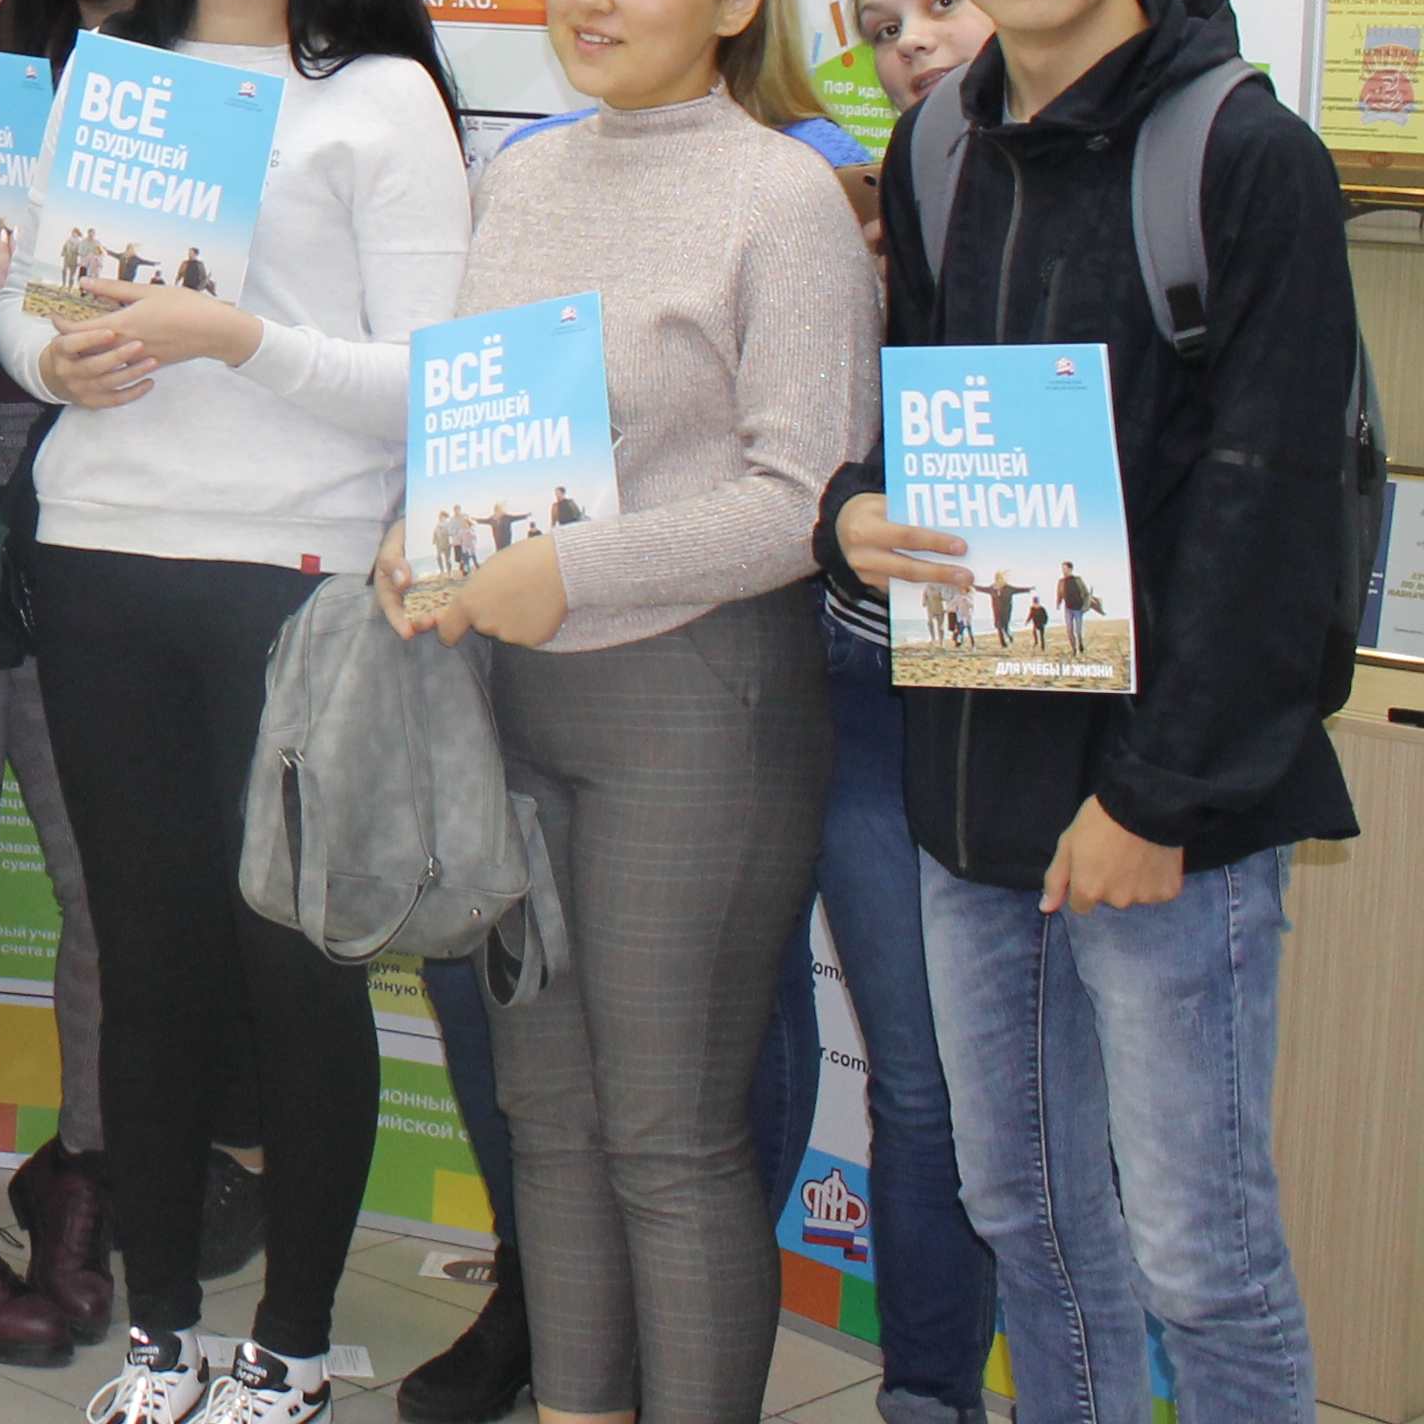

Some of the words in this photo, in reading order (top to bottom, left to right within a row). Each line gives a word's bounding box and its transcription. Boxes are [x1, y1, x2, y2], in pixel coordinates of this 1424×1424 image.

[80, 71, 173, 138] ВСЁ
[823, 80, 854, 94] ПФР
[76, 125, 88, 146] О
[91, 129, 188, 171] БУДУЩЕЙ
[67, 150, 222, 223] ПЕНСИИ
[425, 334, 504, 408] ВСЁ
[425, 412, 437, 434] О
[441, 390, 530, 429] БУДУЩЕЙ
[902, 375, 996, 447] ВСЁ
[426, 416, 572, 478] ПЕНСИИ
[905, 454, 918, 476] О
[922, 447, 1029, 480] БУДУЩЕЙ
[906, 483, 1080, 529] ПЕНСИИ
[995, 662, 1019, 675] ДЛЯ
[1062, 663, 1070, 676] И
[1072, 664, 1113, 677] ЖИЗНИ
[2, 943, 42, 956] счета
